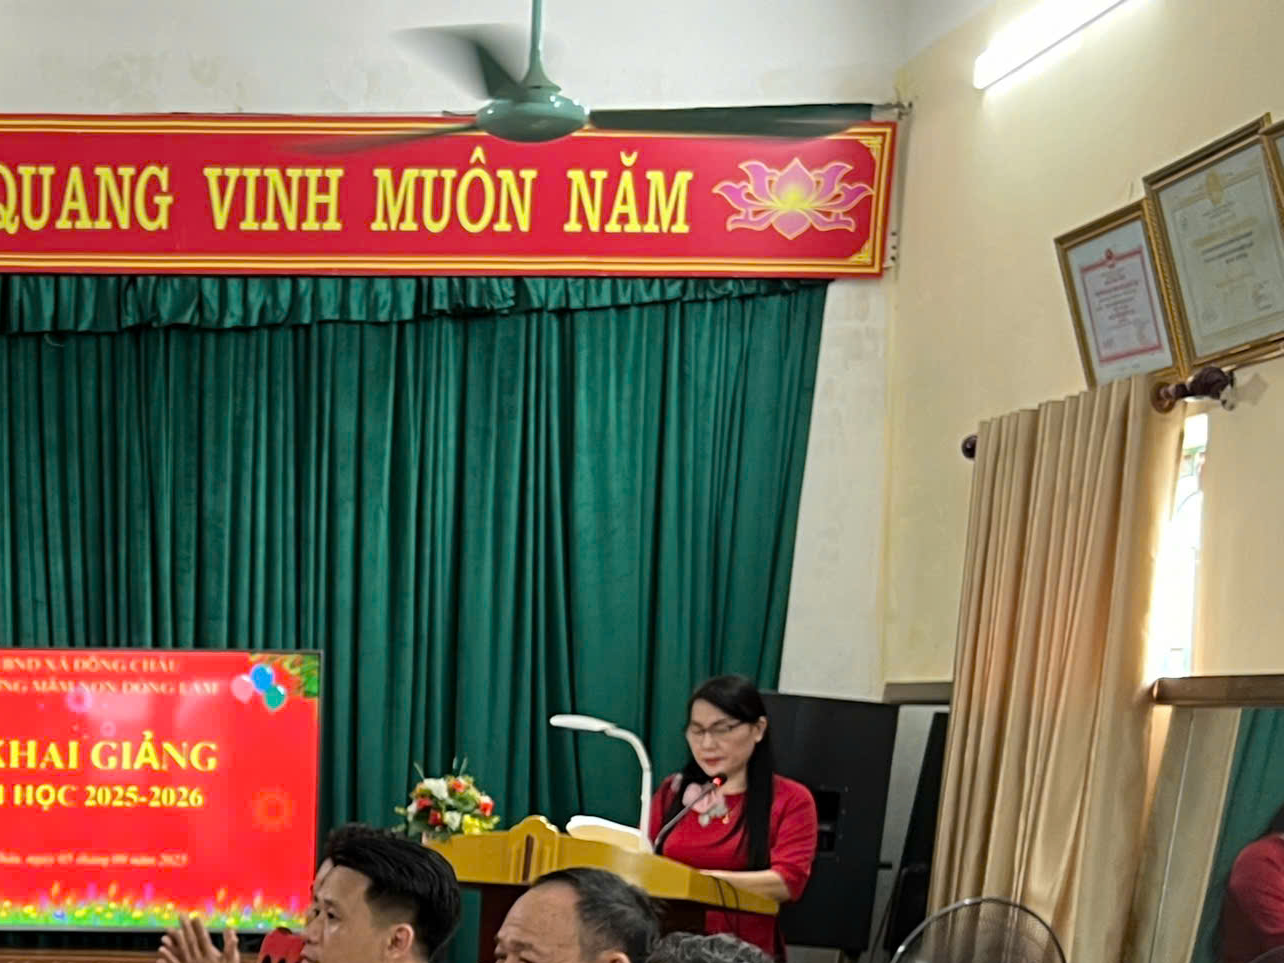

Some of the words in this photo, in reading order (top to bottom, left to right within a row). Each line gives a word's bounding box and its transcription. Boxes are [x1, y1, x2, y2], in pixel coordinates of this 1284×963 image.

[204, 167, 344, 231] VINH
[372, 147, 538, 233] MUÔN
[564, 152, 693, 234] NĂM
[89, 730, 218, 772] GIẢNG
[13, 783, 76, 811] HỌC
[84, 785, 205, 808] 2025-2026
